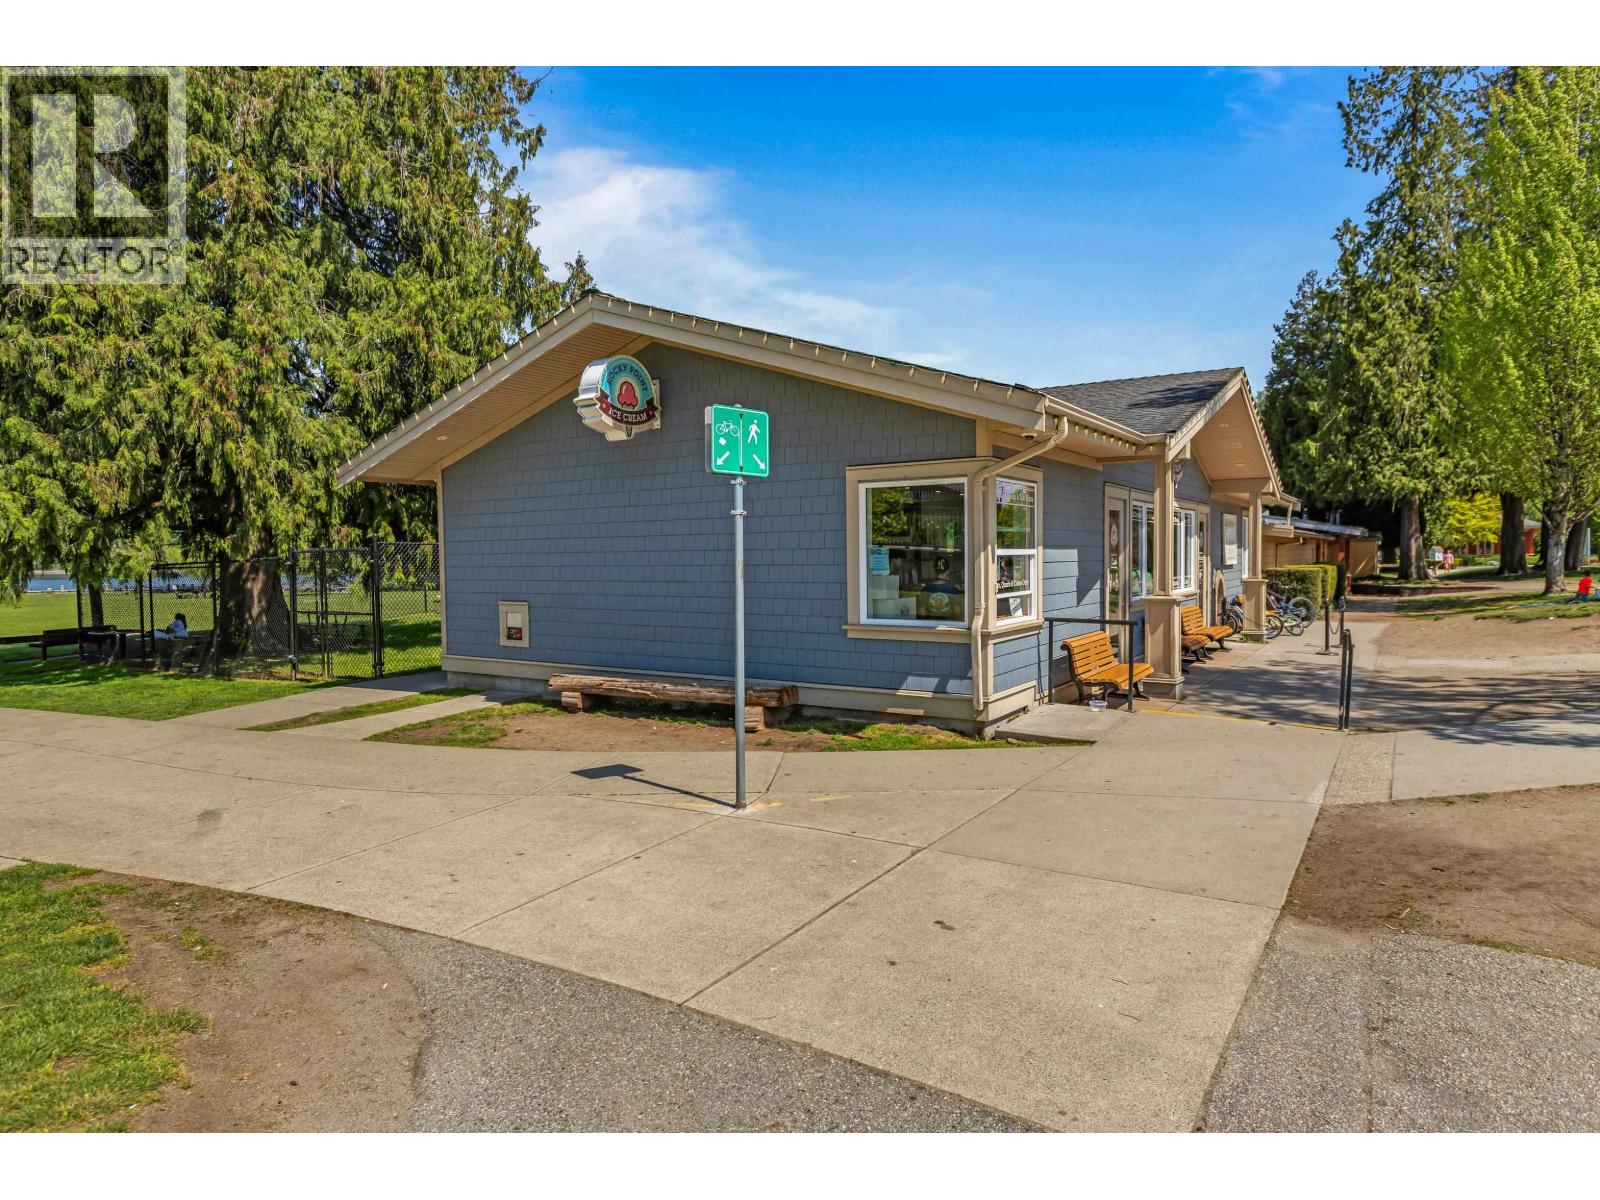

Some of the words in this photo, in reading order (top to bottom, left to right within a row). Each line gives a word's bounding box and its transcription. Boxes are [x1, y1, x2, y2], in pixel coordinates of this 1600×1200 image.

[607, 364, 627, 384] ROCKY
[630, 366, 648, 391] POINT
[608, 407, 621, 419] ICE
[623, 412, 647, 422] CREAM
